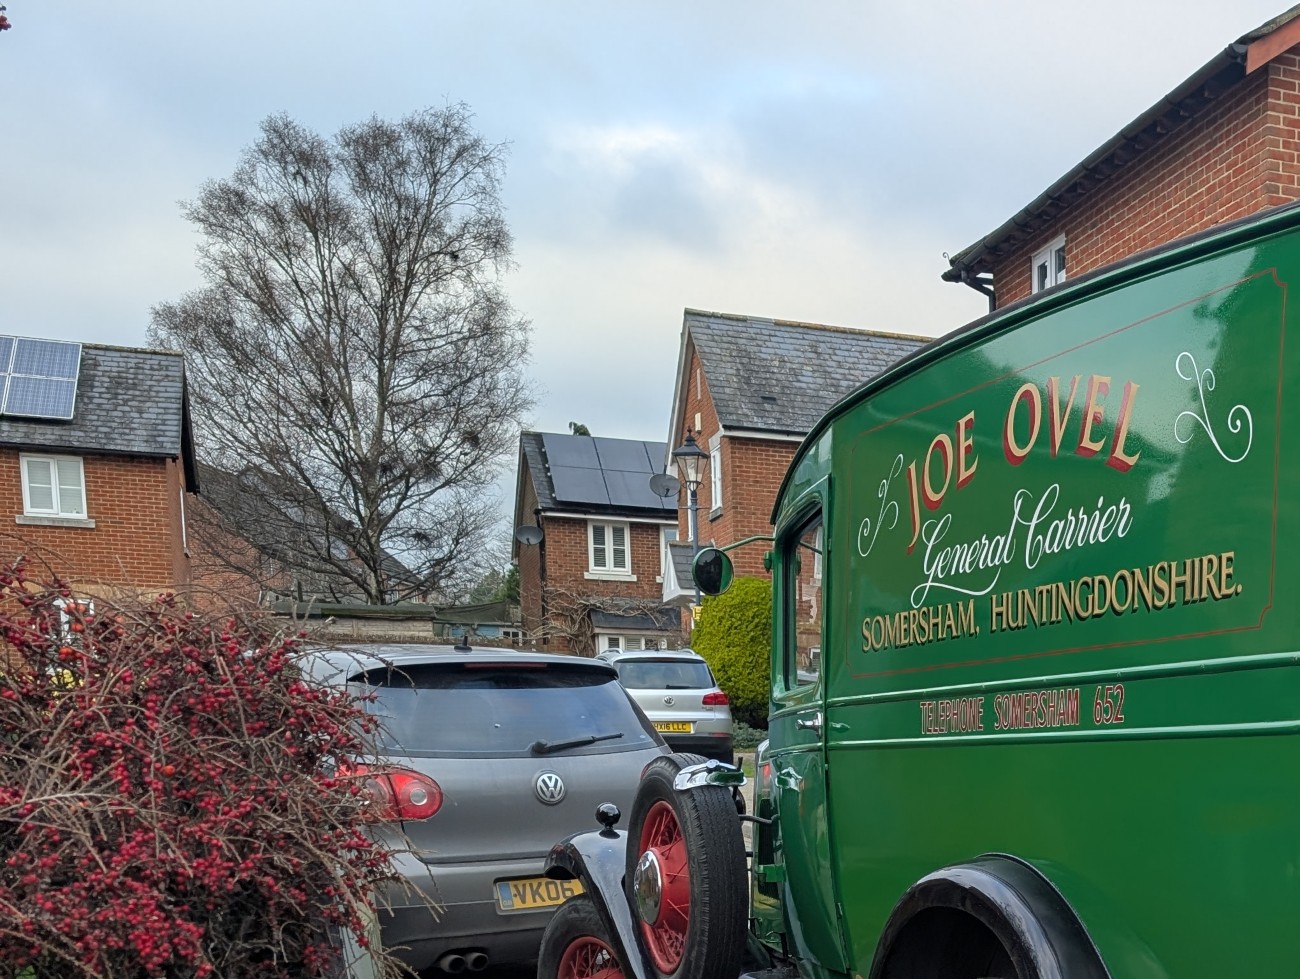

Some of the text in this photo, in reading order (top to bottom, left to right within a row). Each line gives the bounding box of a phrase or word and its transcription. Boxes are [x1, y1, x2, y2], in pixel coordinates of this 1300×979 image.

[906, 374, 1142, 555] JOE OVEL
[861, 550, 1243, 653] SOMERSHAM, HUNTINGDONSHIRE.
[911, 483, 1133, 608] General Carrier
[920, 683, 1125, 735] TELEPHONE SOMERSHAM 652
